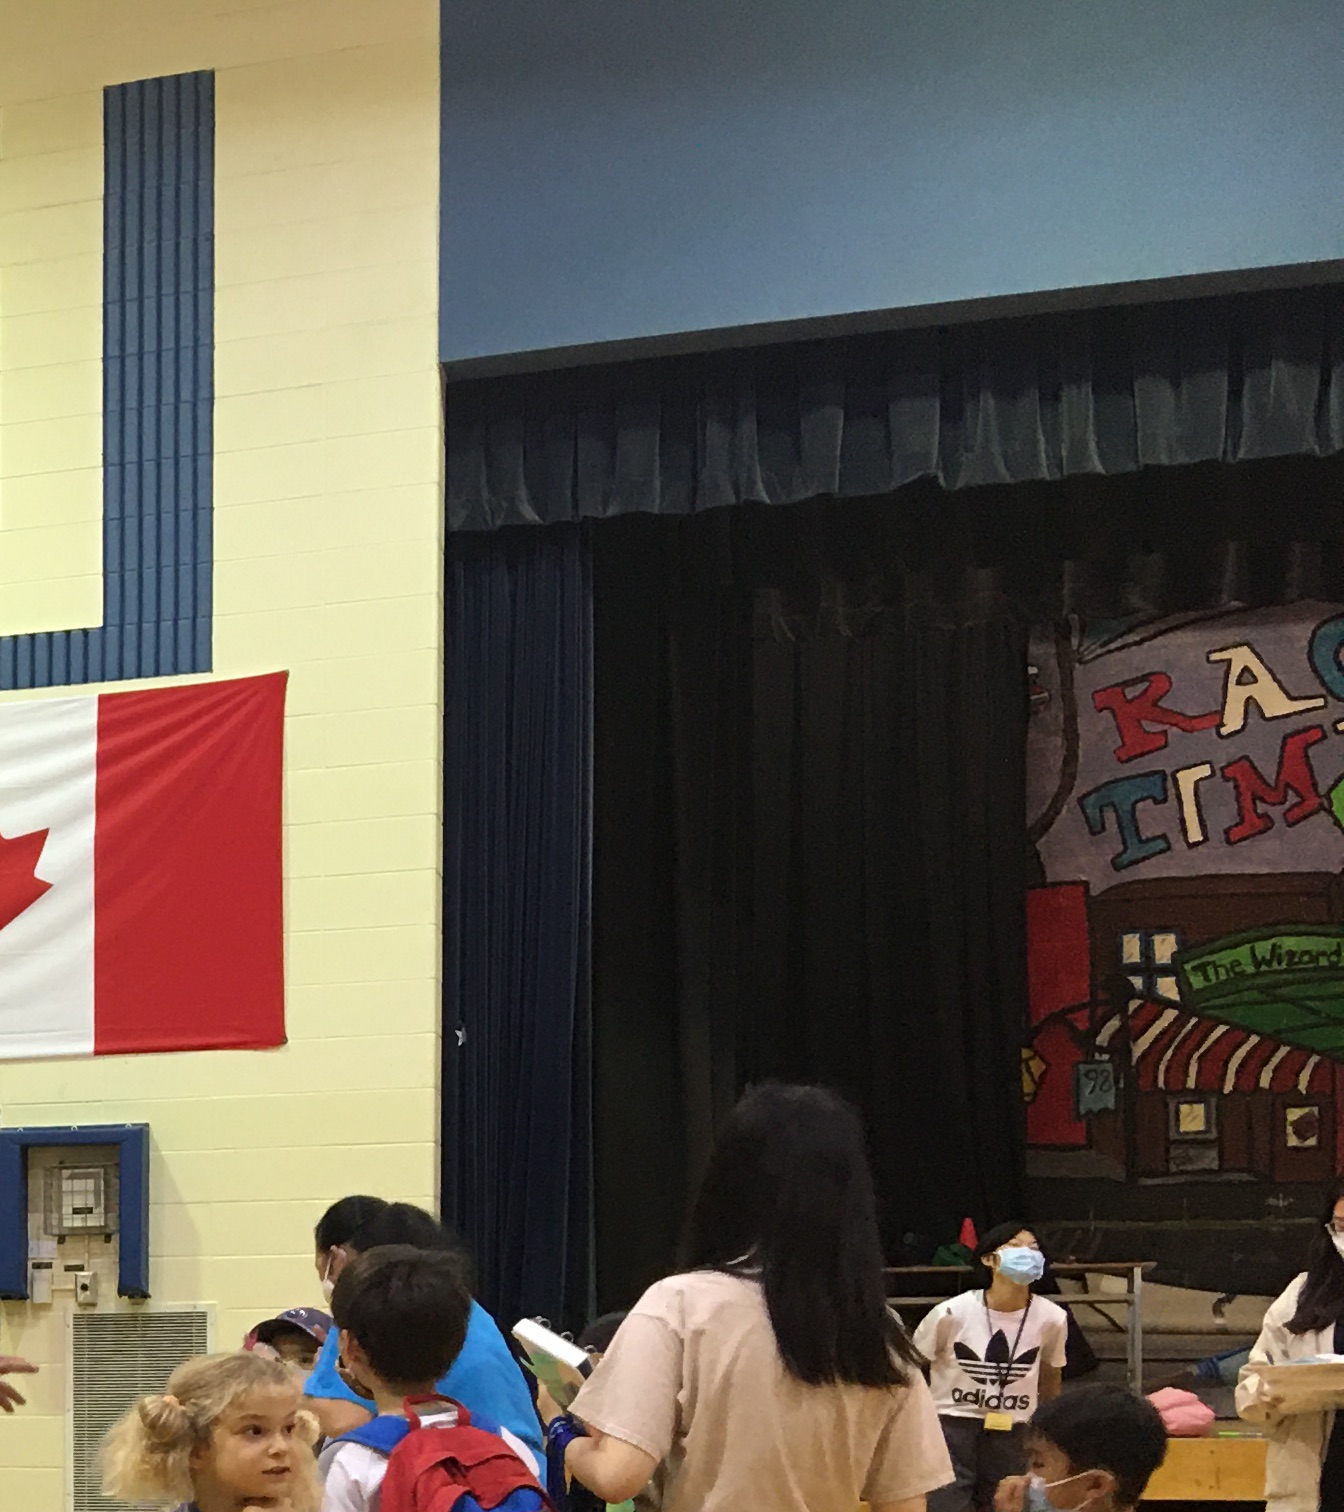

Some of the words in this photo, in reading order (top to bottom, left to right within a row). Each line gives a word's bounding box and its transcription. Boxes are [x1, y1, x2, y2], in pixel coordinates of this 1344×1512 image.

[1192, 960, 1244, 983] The
[1249, 942, 1341, 970] Wizard
[952, 1388, 1030, 1410] adidas
